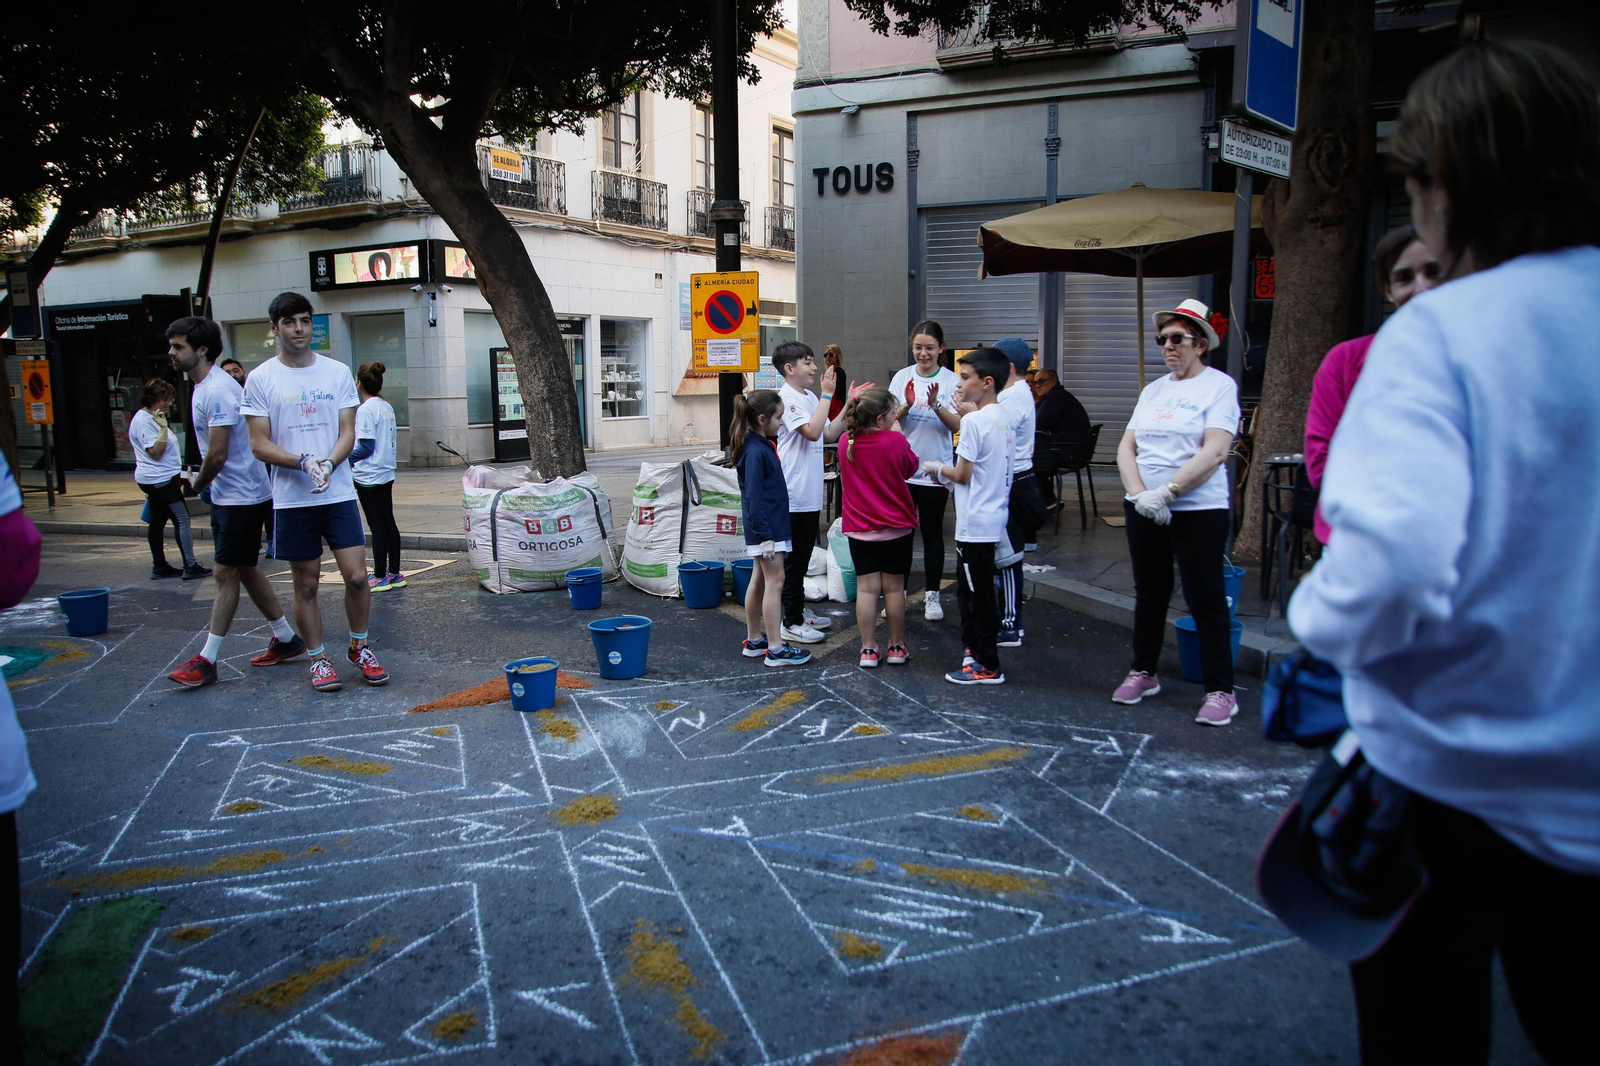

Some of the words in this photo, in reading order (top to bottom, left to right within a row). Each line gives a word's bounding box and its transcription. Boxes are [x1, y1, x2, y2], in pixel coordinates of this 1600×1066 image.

[1226, 127, 1272, 151] AUTORIZADO
[1274, 141, 1289, 157] TAXI
[493, 155, 499, 163] SE
[500, 156, 520, 167] ALQUILA
[1226, 143, 1234, 155] DE
[1236, 147, 1251, 160] 23:00
[1266, 156, 1280, 169] 07:00
[493, 169, 502, 178] 950
[813, 162, 894, 195] TOUS
[704, 278, 730, 286] ALMERÍA
[55, 316, 70, 324] Oficina
[71, 316, 77, 324] de
[77, 314, 106, 323] Información
[518, 535, 584, 552] ORTIGOSA
